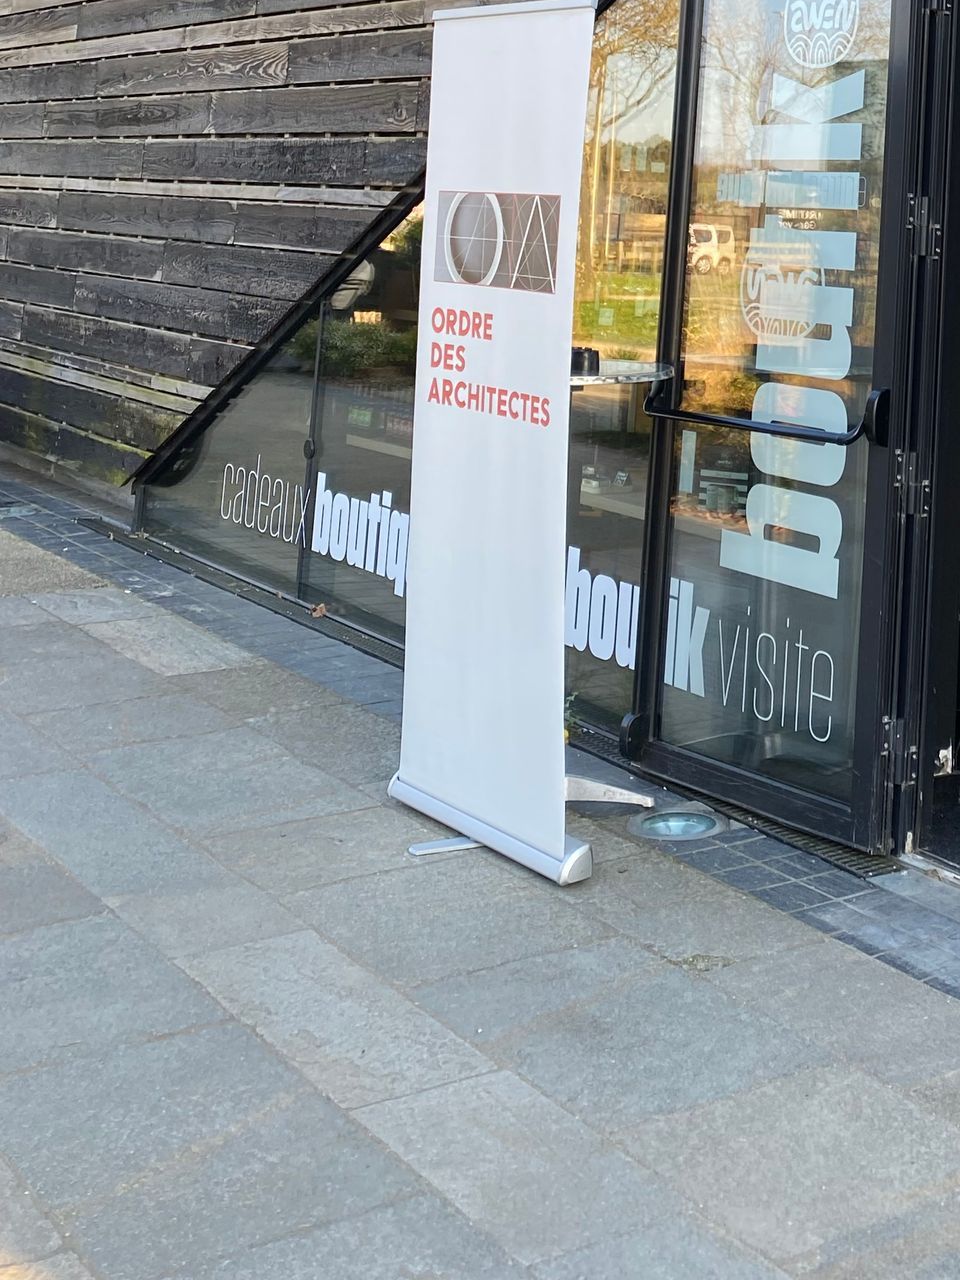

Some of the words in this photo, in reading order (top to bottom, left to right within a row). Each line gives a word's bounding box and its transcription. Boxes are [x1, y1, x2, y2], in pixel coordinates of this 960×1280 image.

[431, 306, 494, 341] ORDRE
[430, 341, 466, 373] DES
[427, 376, 550, 428] ARCHITECTES
[220, 454, 311, 549] cadeaux
[311, 471, 410, 598] boutiq
[563, 545, 711, 699] bouik
[718, 605, 835, 743] visite
